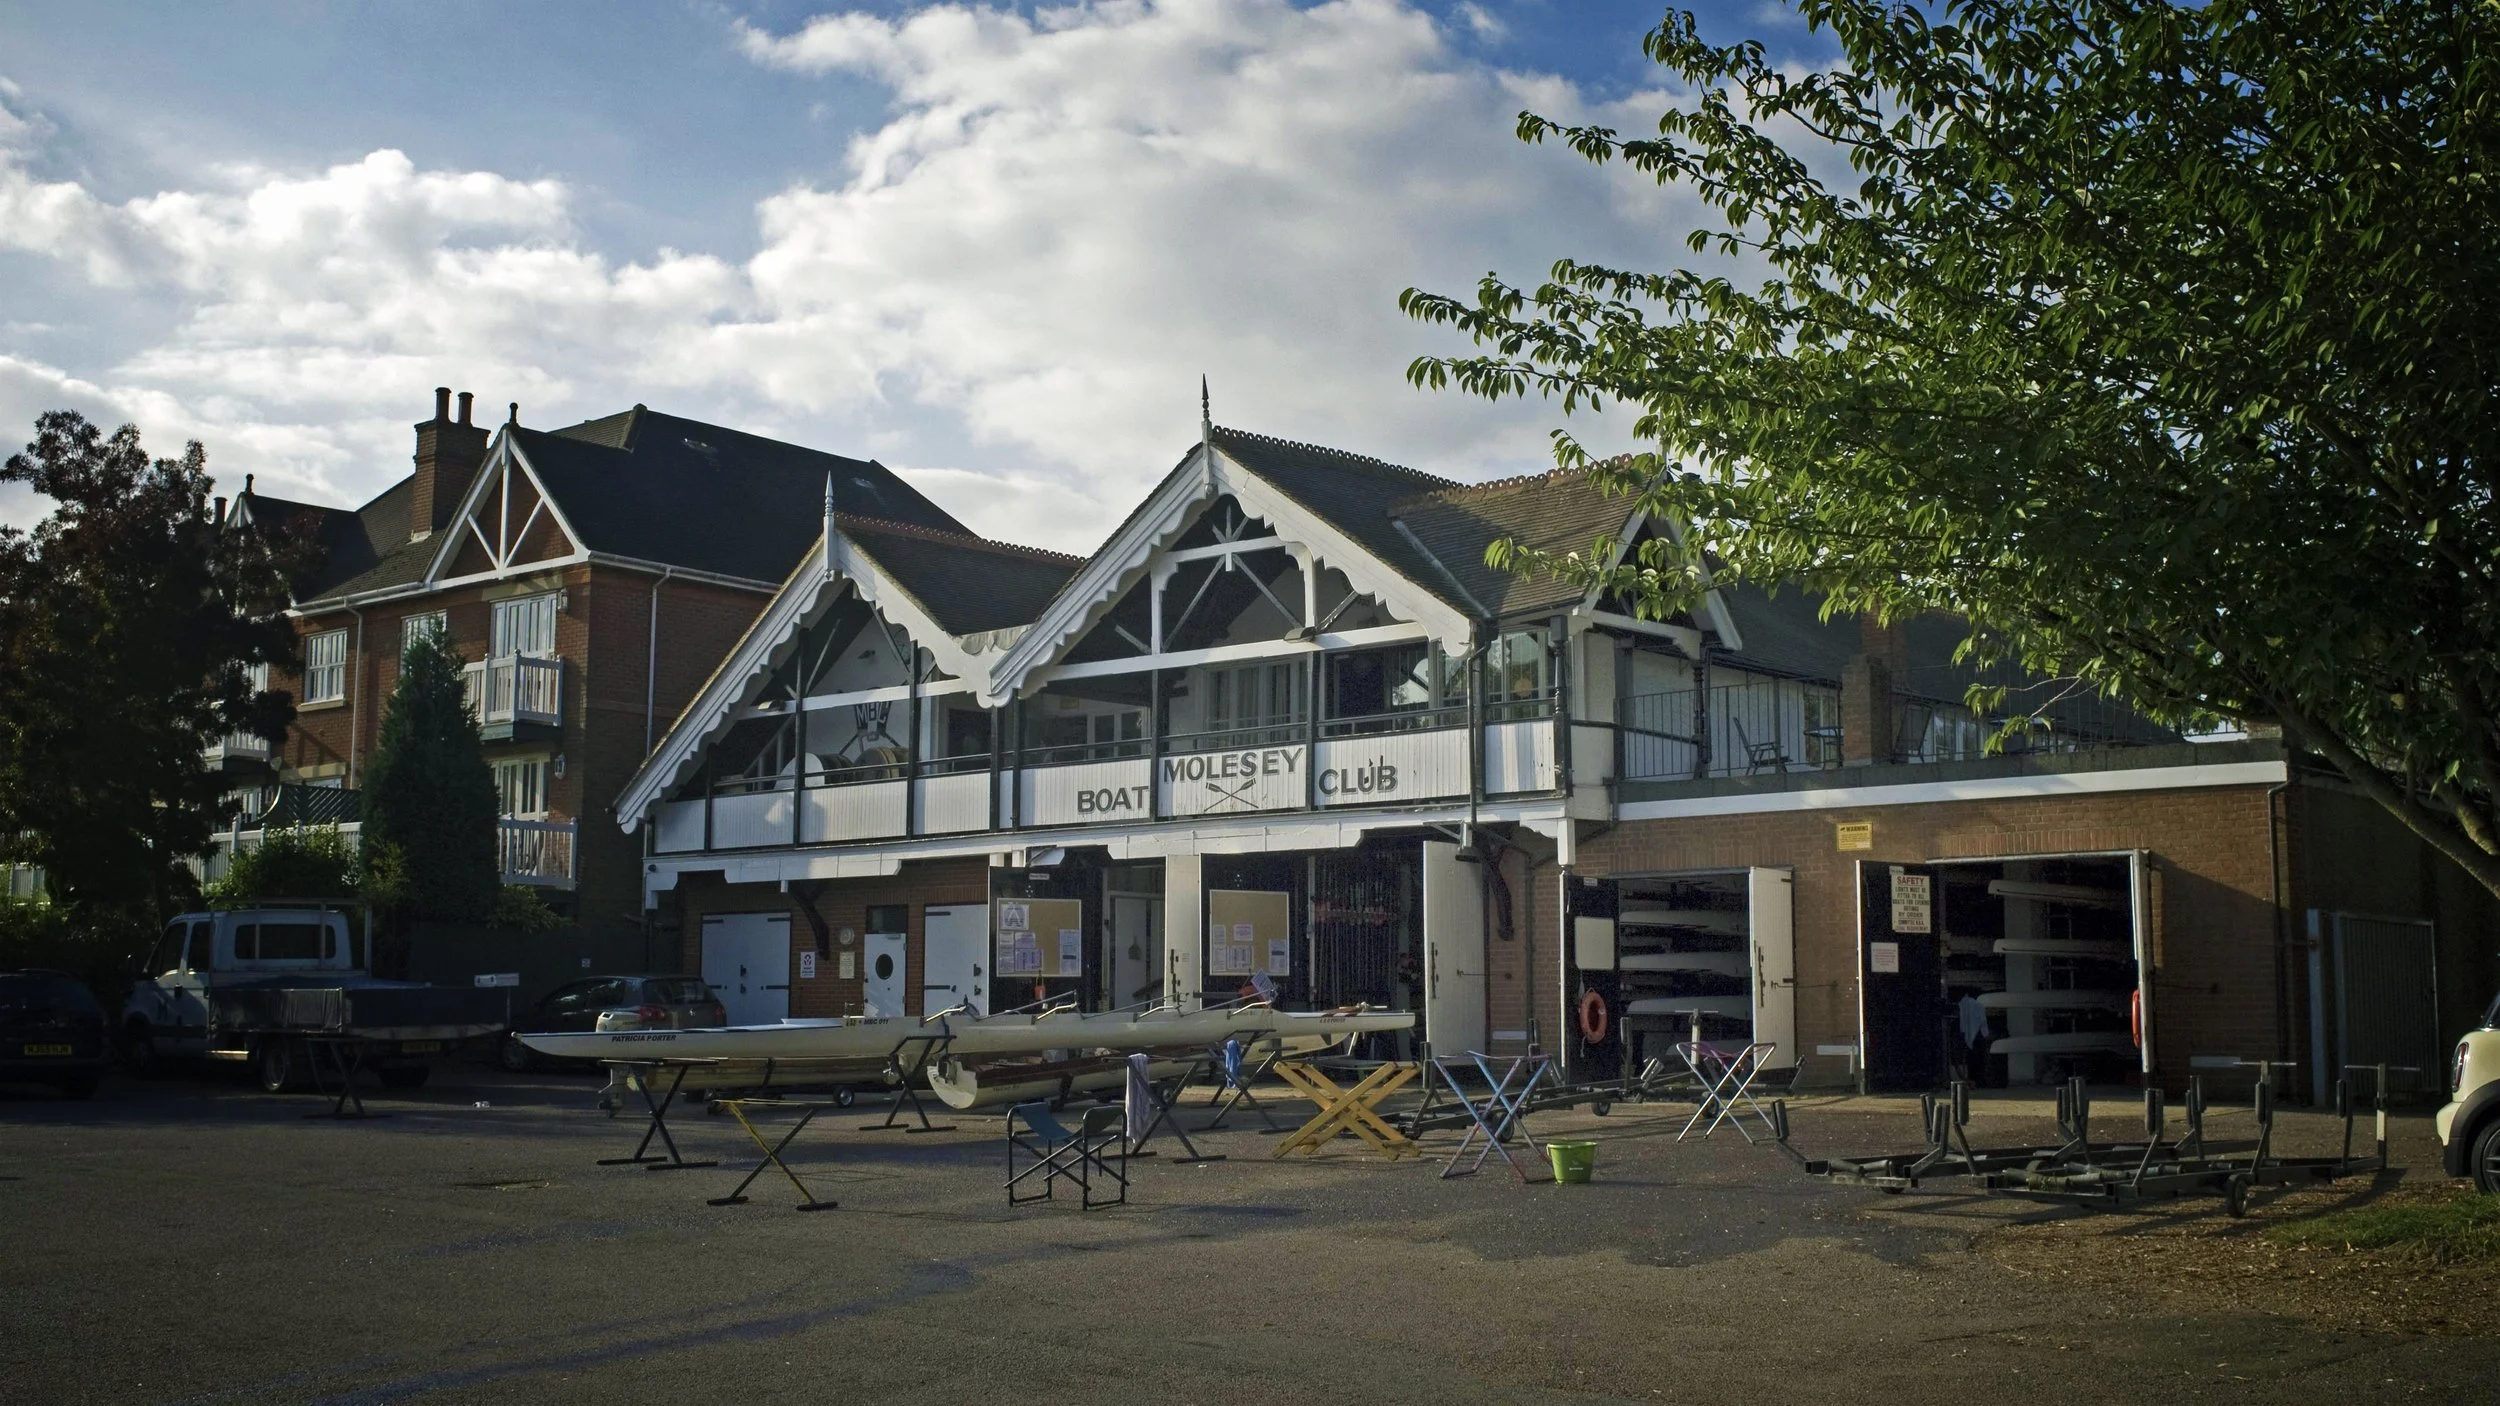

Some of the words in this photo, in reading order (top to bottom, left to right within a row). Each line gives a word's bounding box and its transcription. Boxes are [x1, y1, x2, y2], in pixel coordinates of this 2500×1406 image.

[1077, 785, 1149, 814] BOAT
[1163, 747, 1304, 783] MOLESEY
[1318, 764, 1399, 796] CLUB
[1897, 876, 1924, 885] SAFETY
[611, 1034, 645, 1042] PATRICIA
[646, 1034, 677, 1042] PORTER
